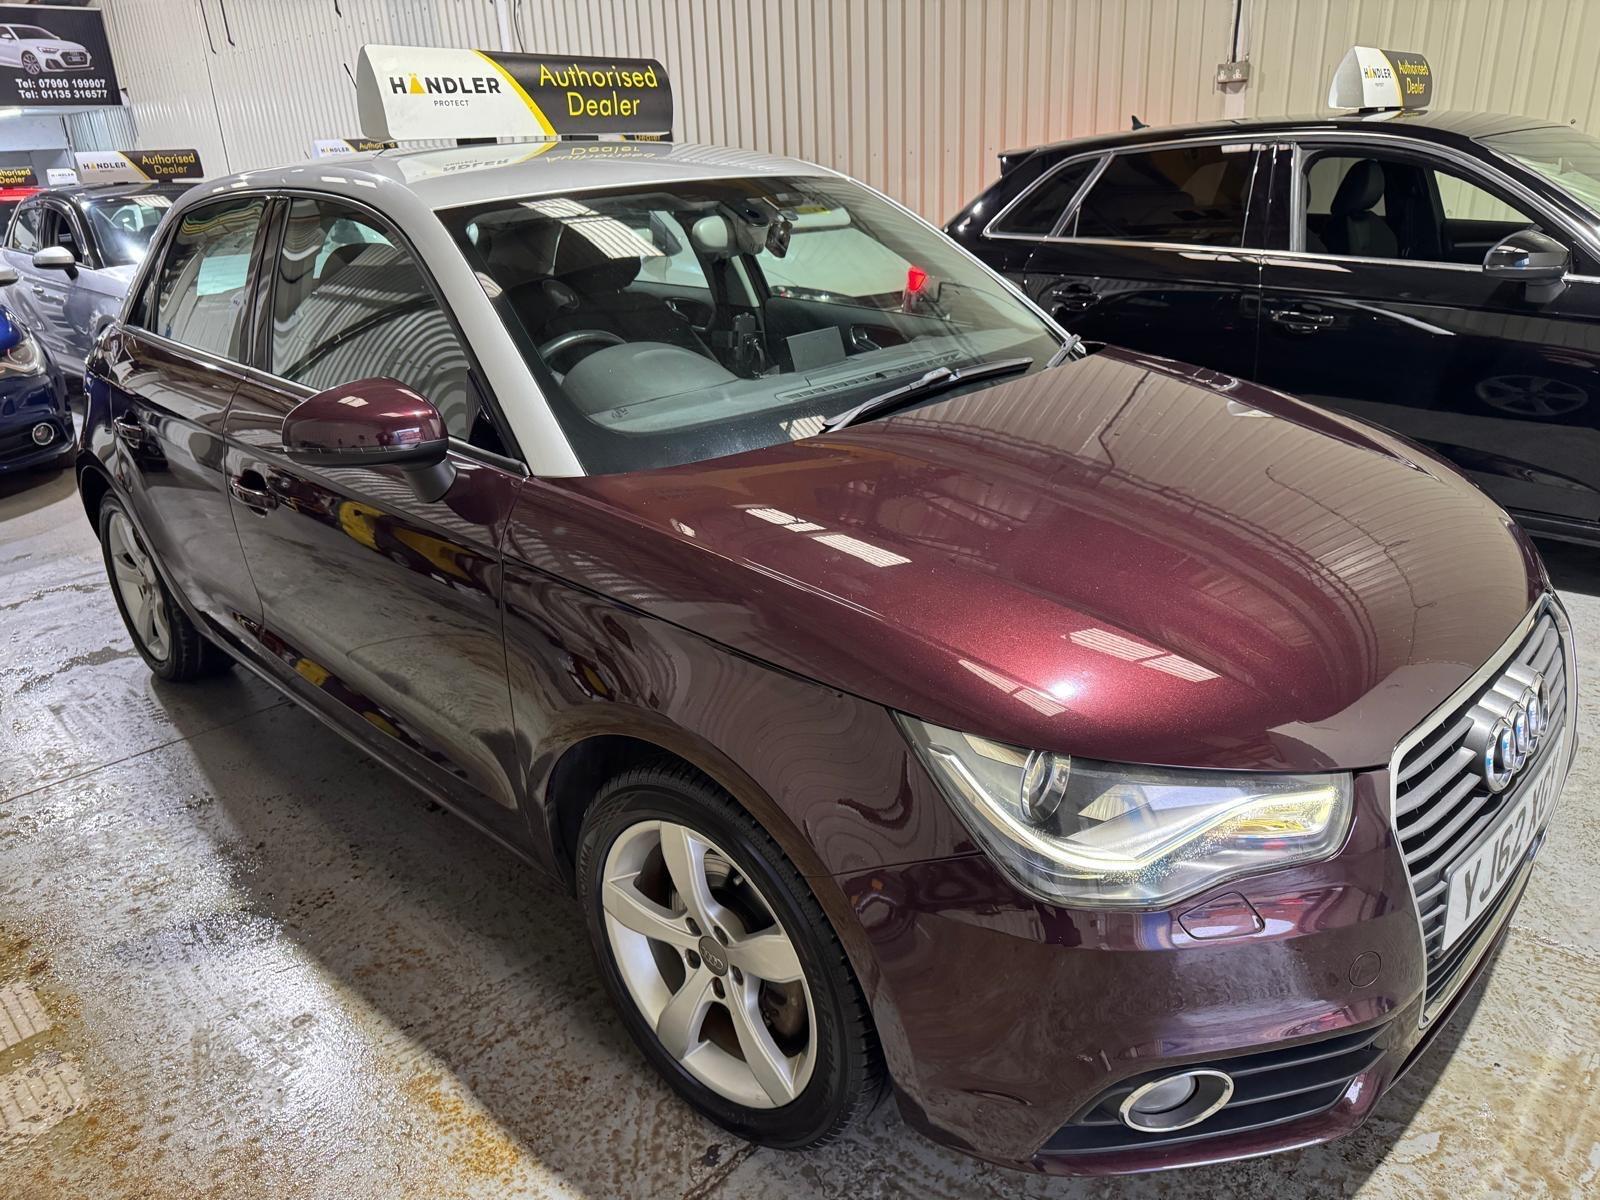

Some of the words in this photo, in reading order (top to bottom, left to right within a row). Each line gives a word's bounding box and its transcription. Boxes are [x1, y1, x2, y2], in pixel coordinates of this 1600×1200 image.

[1398, 60, 1429, 76] Authorised
[540, 63, 658, 88] Authorised
[15, 78, 36, 89] Tel:
[1406, 77, 1426, 94] Dealer
[18, 89, 39, 99] Tel:
[41, 89, 71, 99] 01135
[433, 99, 470, 107] PROTECT
[567, 90, 640, 116] Dealer
[141, 152, 196, 165] Authorised
[153, 164, 188, 175] Dealer
[1464, 805, 1527, 921] YJ62
